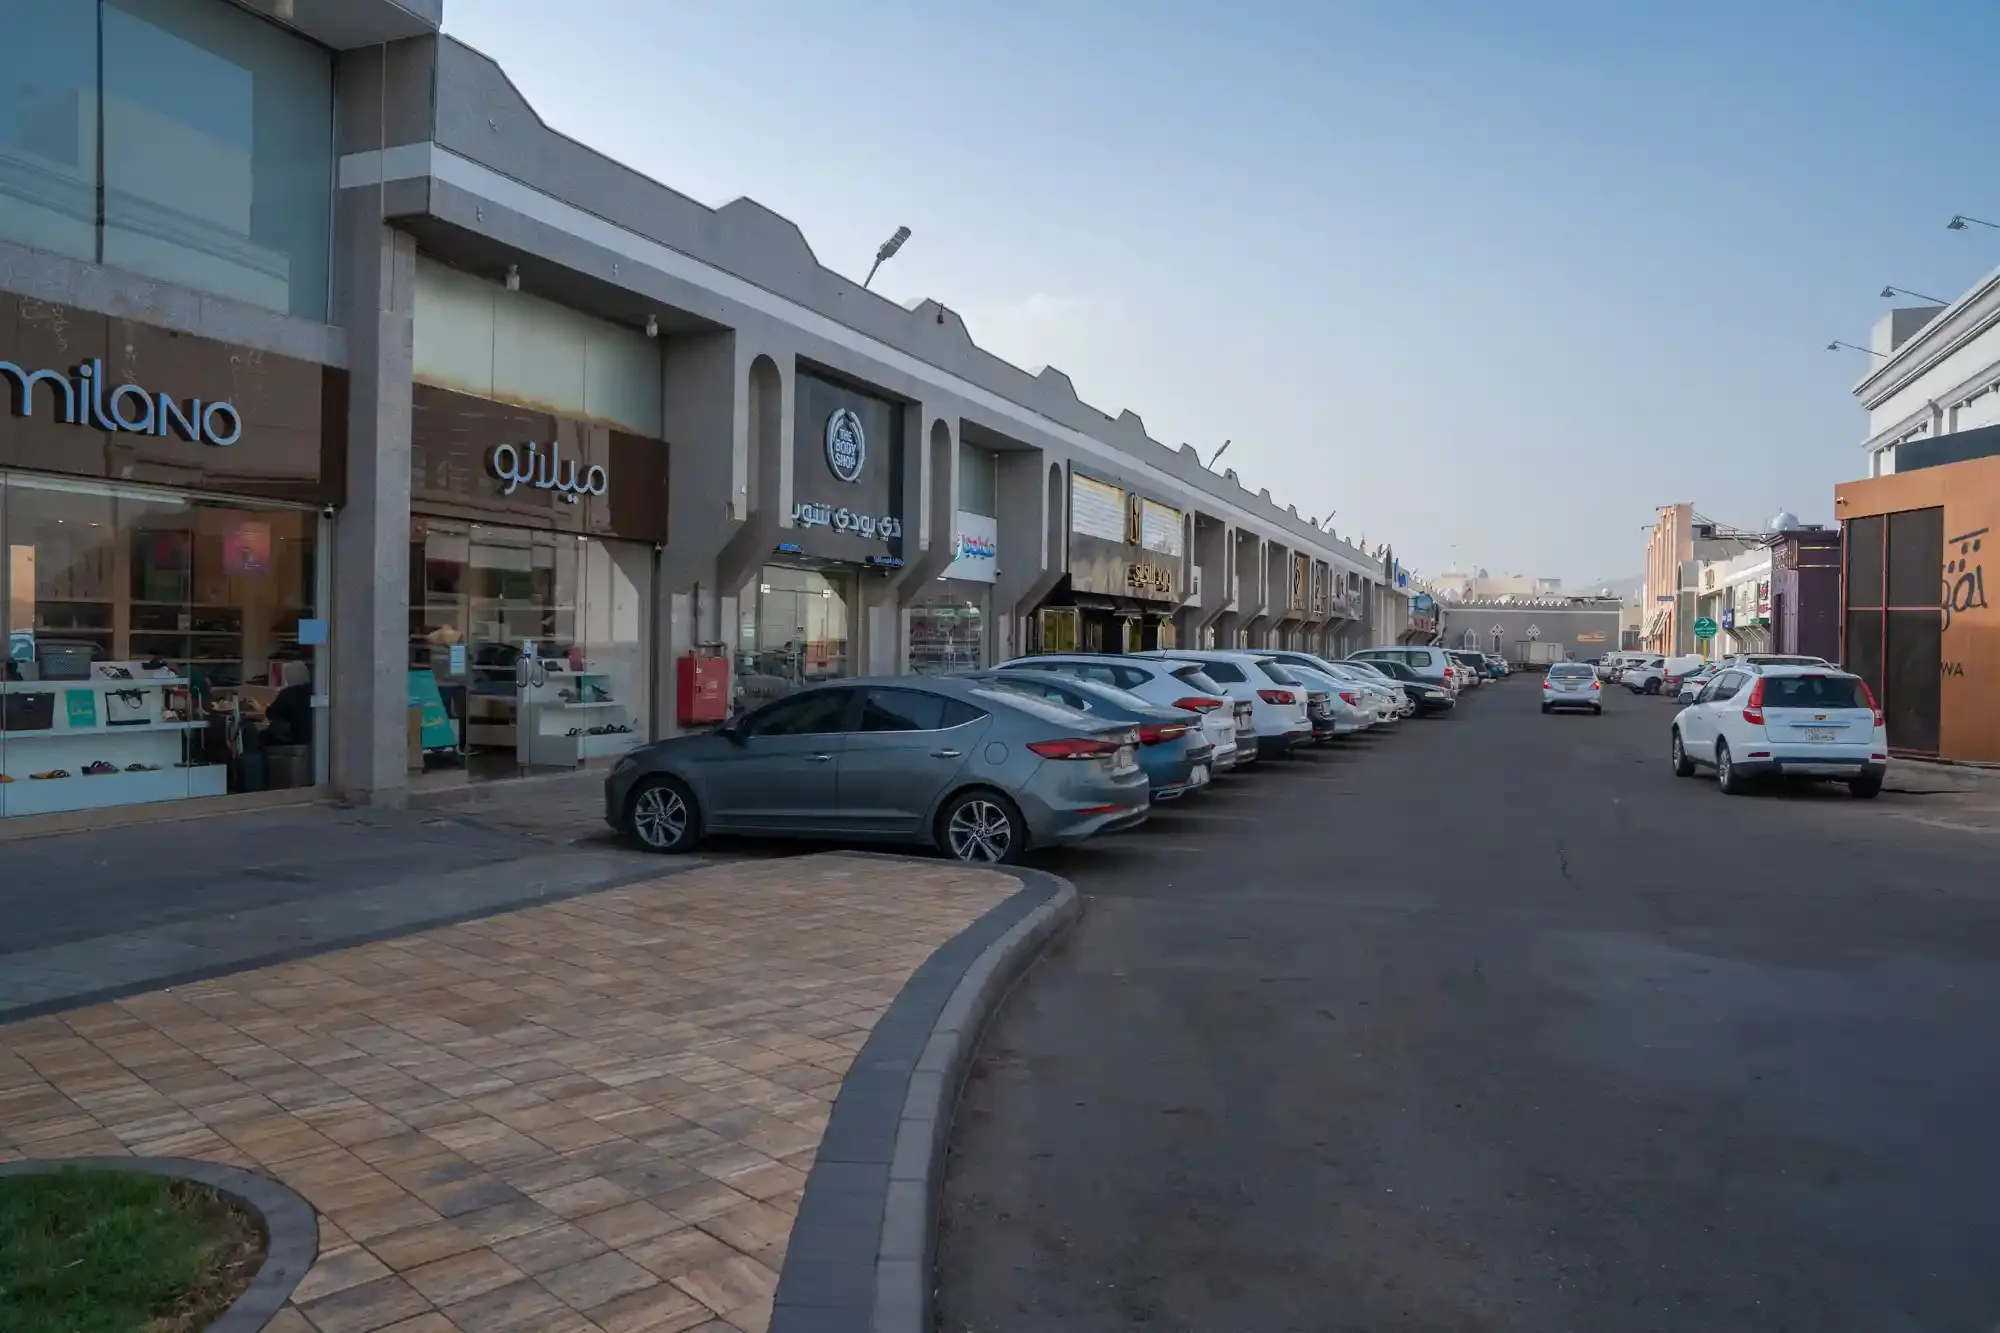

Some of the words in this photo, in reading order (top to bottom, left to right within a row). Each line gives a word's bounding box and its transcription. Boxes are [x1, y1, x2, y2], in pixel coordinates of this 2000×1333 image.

[839, 428, 853, 443] THE
[835, 439, 857, 456] BODY
[835, 453, 856, 469] SHOP
[493, 440, 607, 505] ميلانو
[834, 507, 877, 539] بودي
[879, 516, 902, 542] ذي
